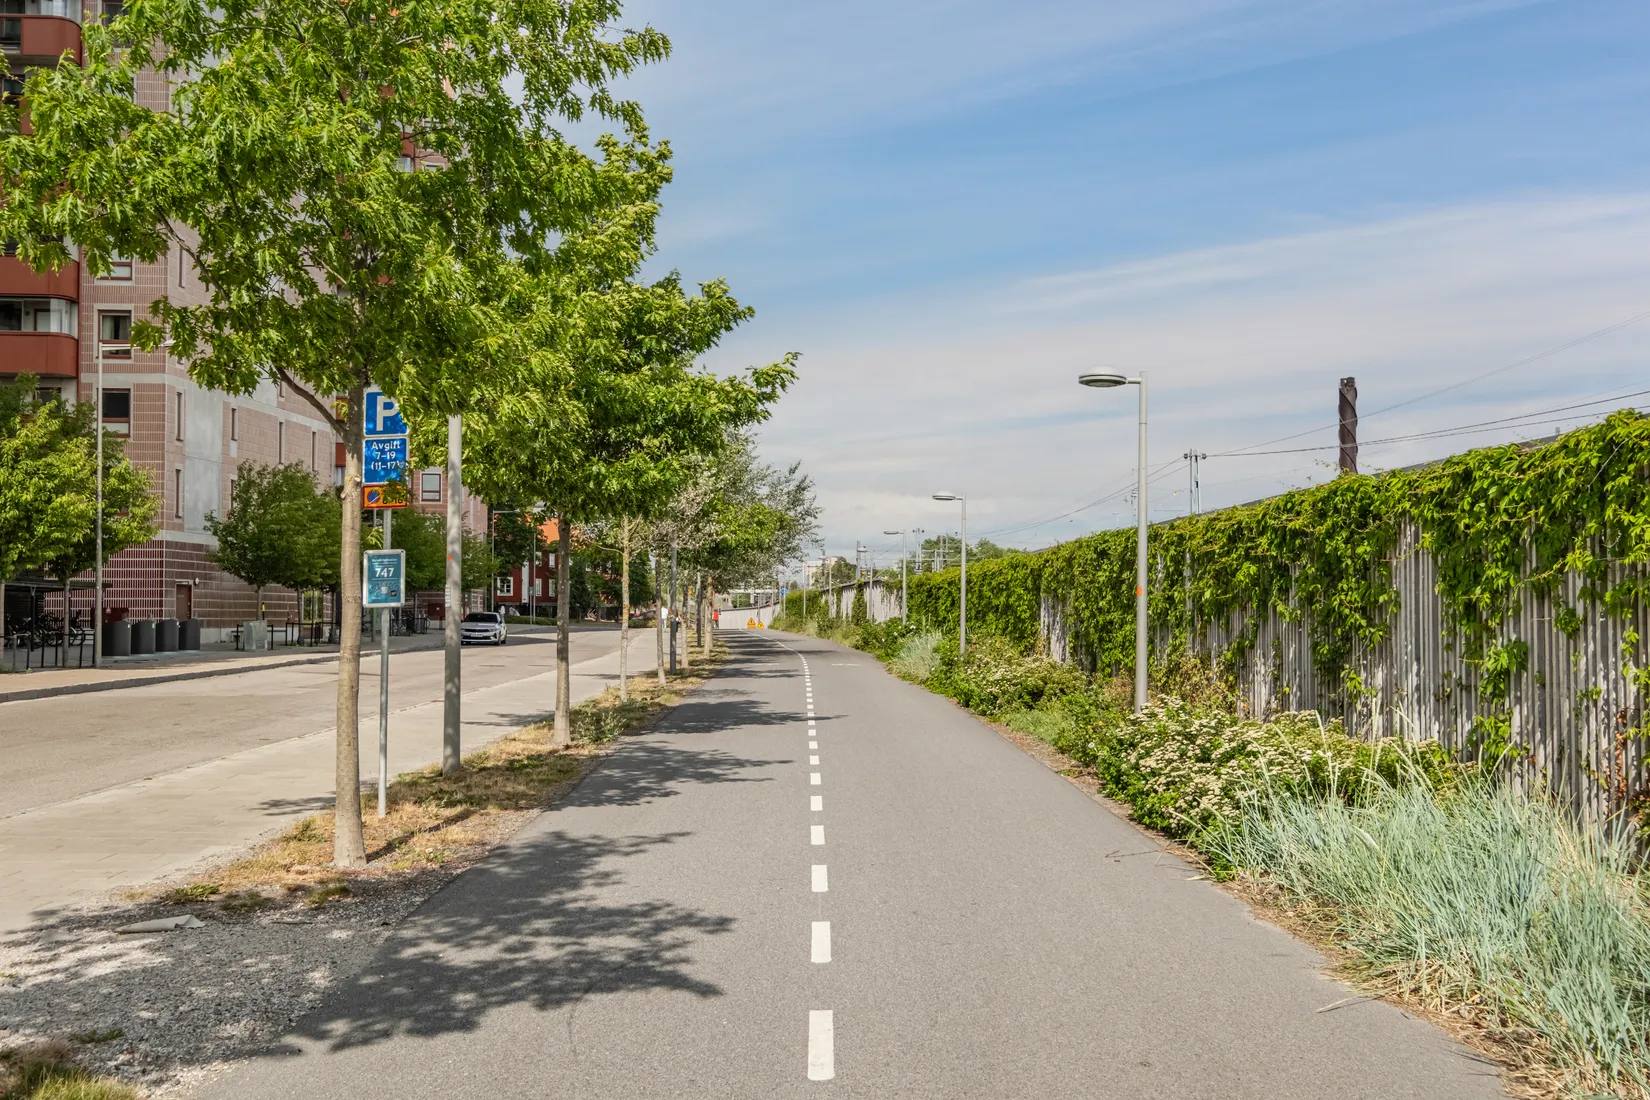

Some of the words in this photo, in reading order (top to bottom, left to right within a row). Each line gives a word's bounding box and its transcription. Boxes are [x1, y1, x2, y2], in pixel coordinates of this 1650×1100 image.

[376, 395, 399, 431] P
[371, 441, 401, 451] Avgift
[375, 451, 396, 460] 7-19
[375, 567, 395, 577] 747
